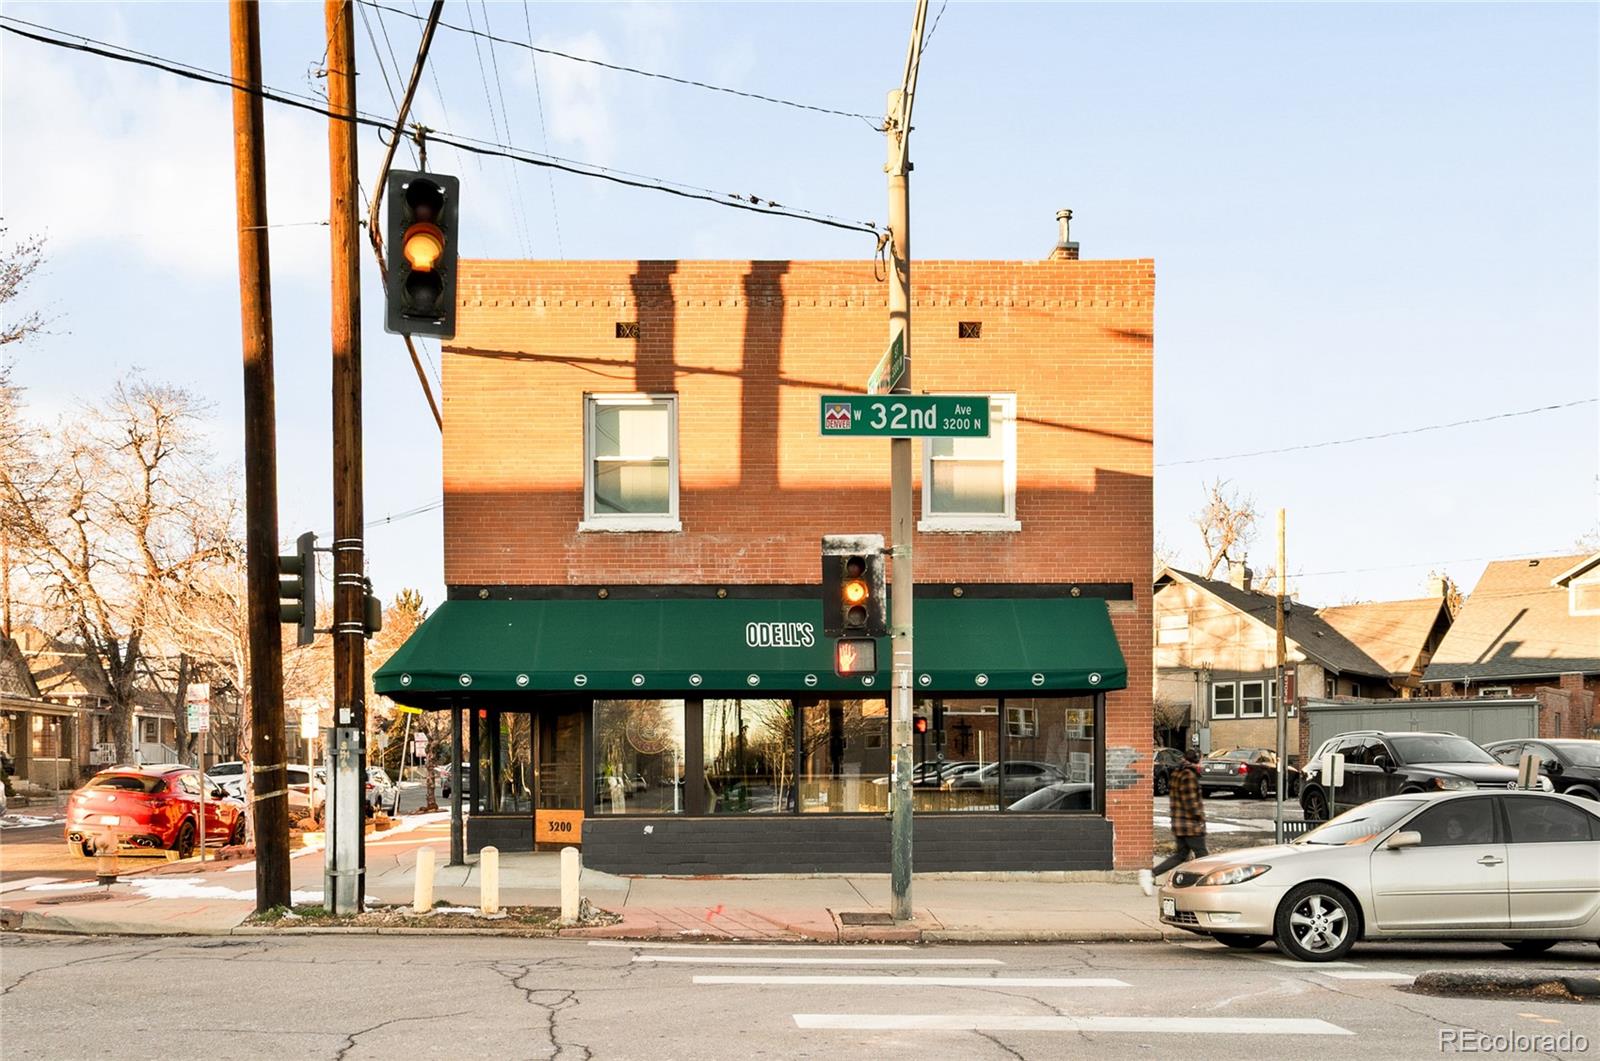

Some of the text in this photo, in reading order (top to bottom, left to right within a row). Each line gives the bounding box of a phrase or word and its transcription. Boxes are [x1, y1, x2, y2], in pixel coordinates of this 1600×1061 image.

[954, 404, 972, 415] Ave
[853, 402, 937, 430] W 32nd
[943, 418, 981, 430] 3200 N
[745, 622, 815, 647] ODELL'S
[548, 821, 572, 832] 3200
